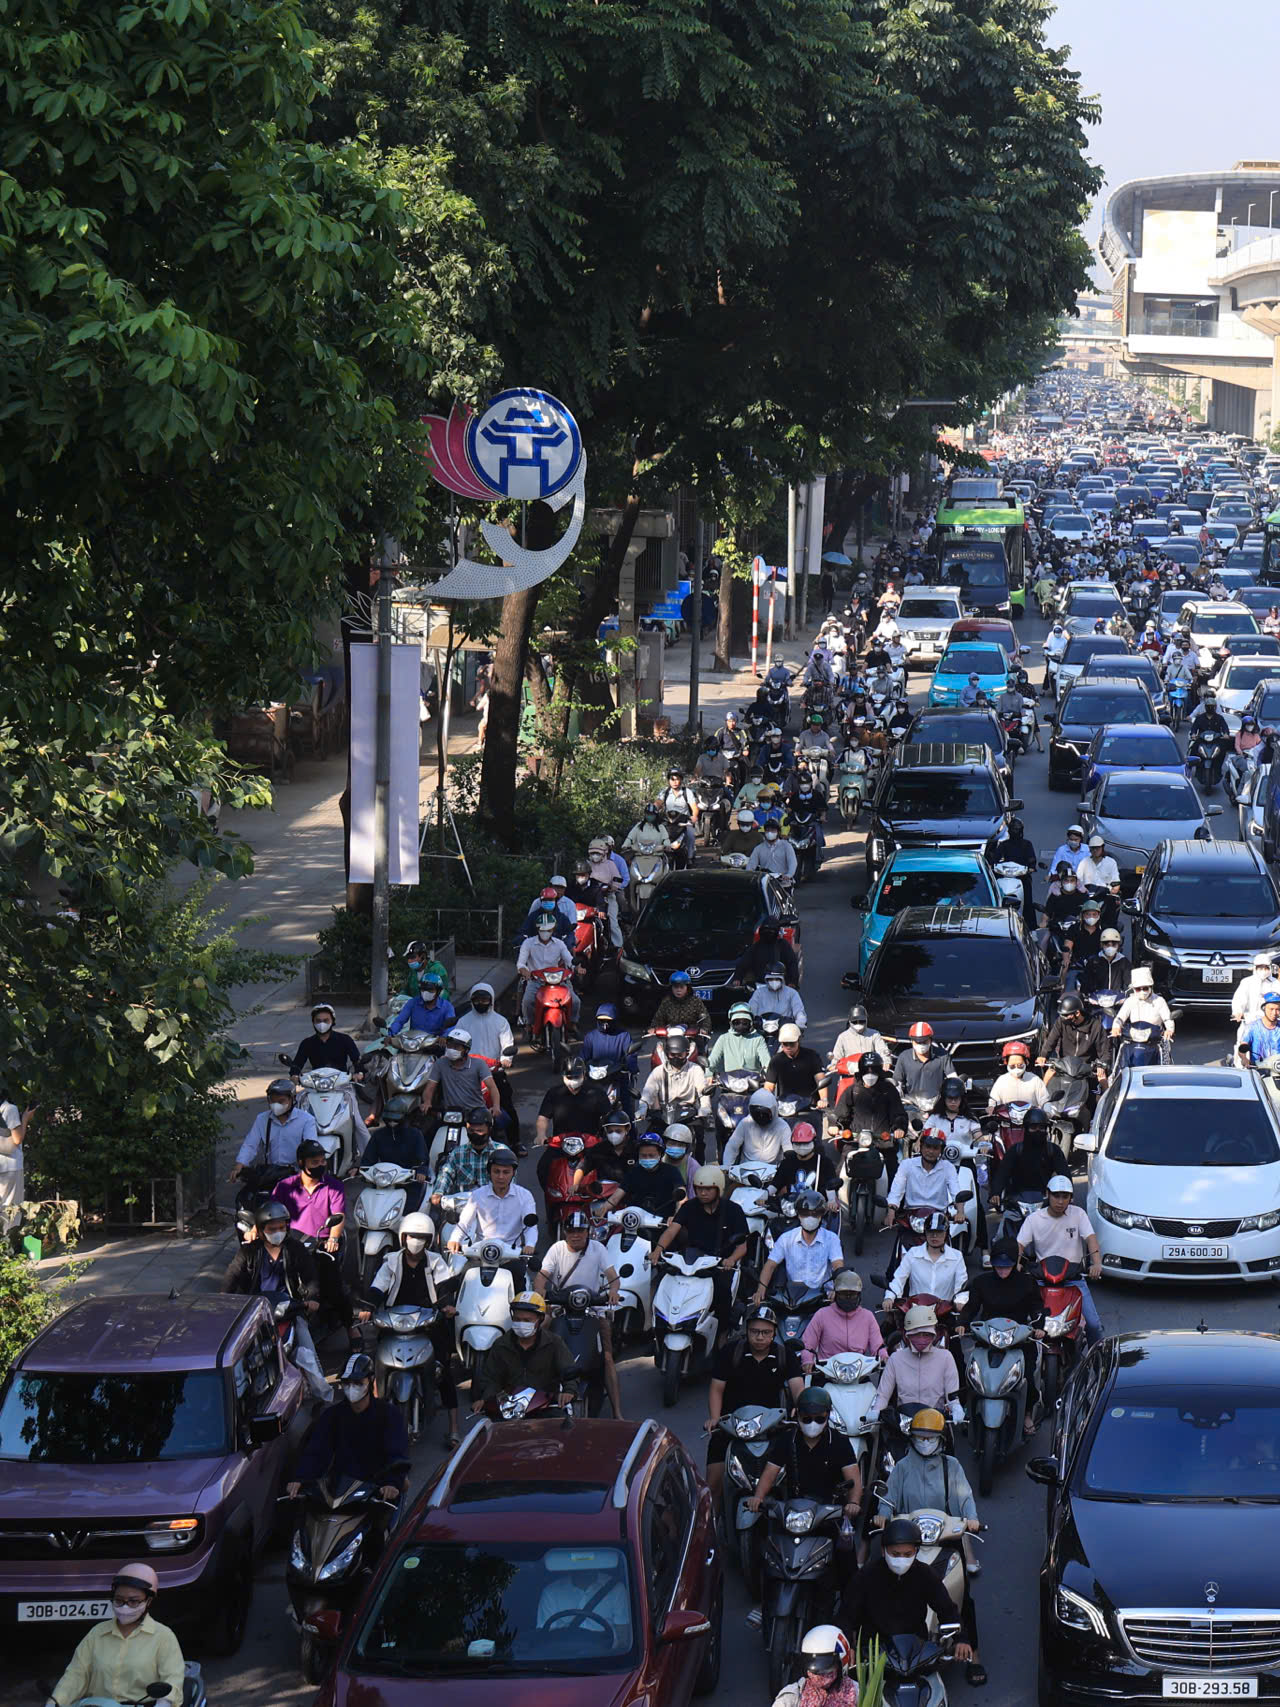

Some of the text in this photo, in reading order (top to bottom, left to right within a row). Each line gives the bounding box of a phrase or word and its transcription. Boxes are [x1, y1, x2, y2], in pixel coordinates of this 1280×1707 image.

[1169, 1247, 1223, 1257] 29A-600.30
[26, 1603, 109, 1618] 30B-024.67
[1170, 1682, 1250, 1695] 30B-293.58
